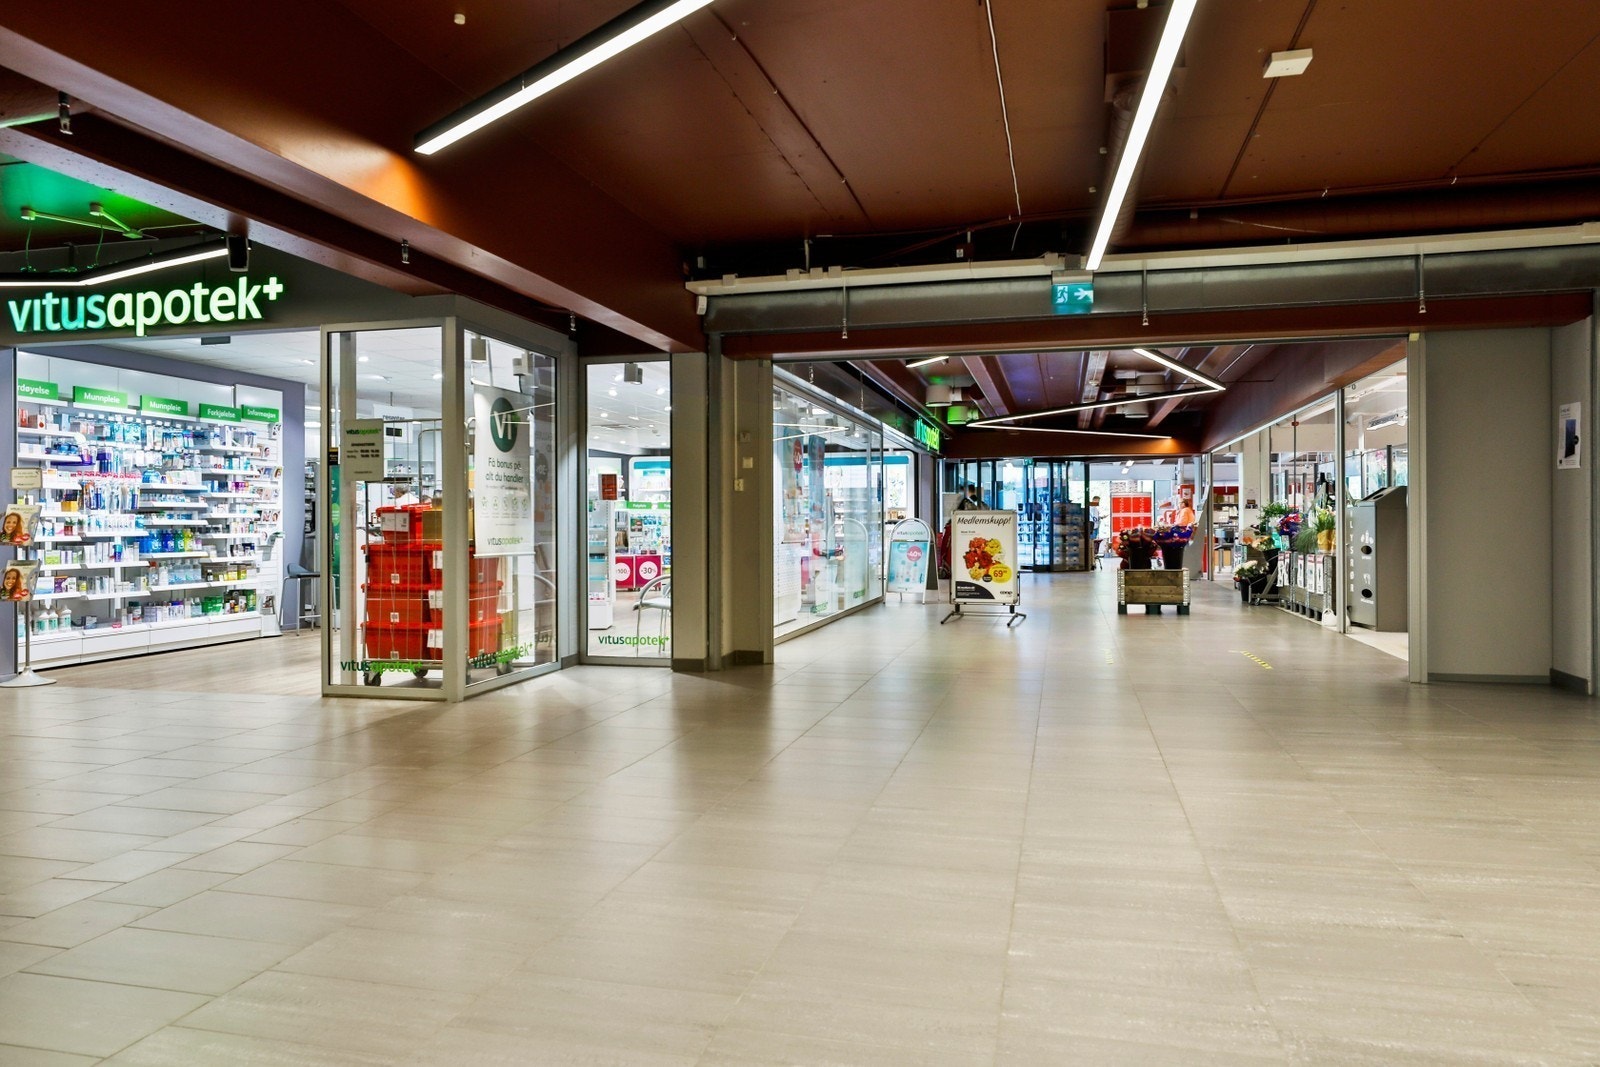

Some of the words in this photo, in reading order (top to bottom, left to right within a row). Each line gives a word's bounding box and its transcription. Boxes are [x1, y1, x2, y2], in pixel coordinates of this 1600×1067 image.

[84, 392, 120, 404] Munnpleie
[149, 401, 182, 412] Munnpleie
[497, 460, 513, 469] bonus
[485, 471, 494, 481] alt
[495, 472, 503, 482] du
[504, 473, 524, 483] handler
[957, 515, 1012, 526] Medlemskupp!
